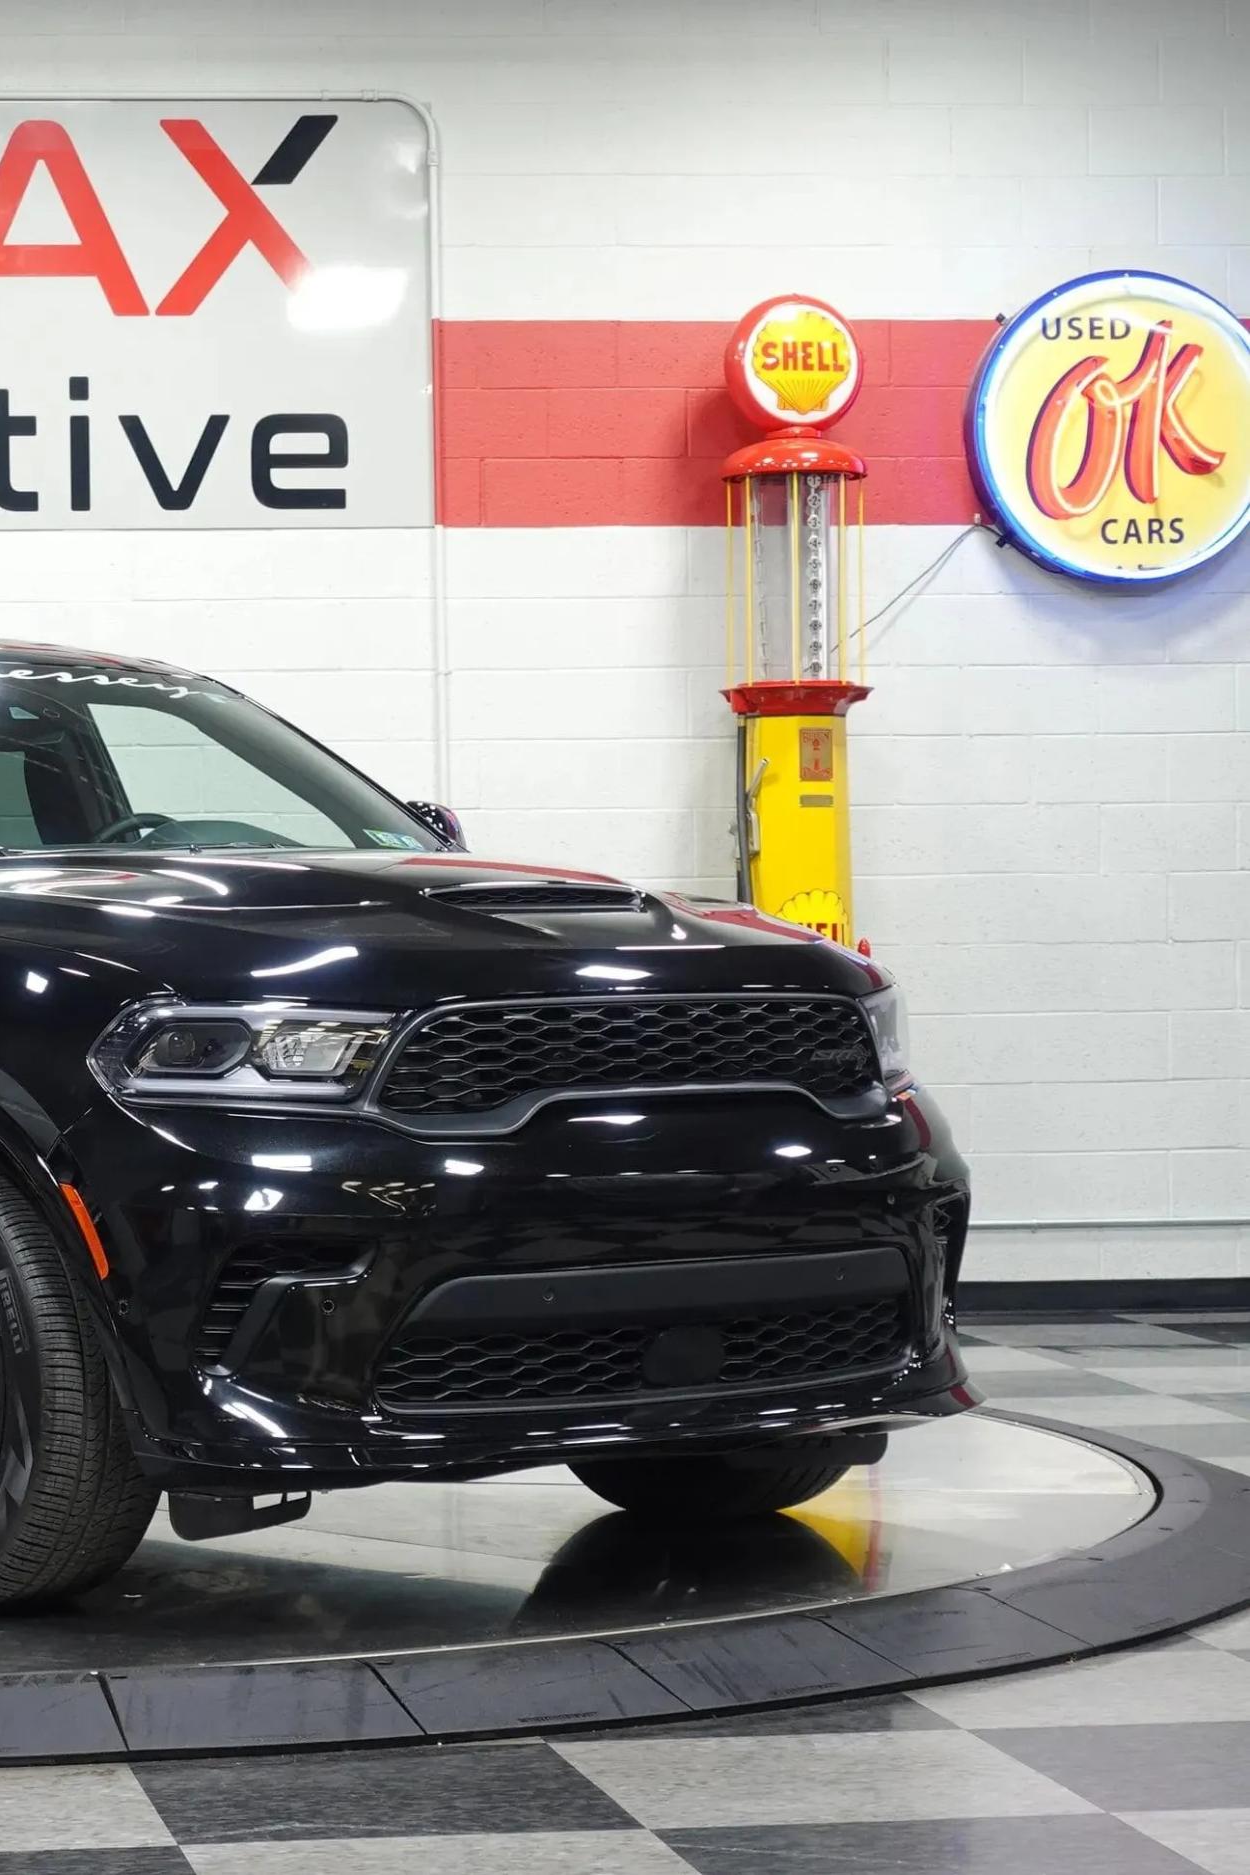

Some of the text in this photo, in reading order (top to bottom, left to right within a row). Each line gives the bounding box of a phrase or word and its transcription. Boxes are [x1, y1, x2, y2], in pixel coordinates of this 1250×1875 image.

[1041, 317, 1131, 341] USED
[761, 341, 845, 373] SHELL
[1026, 320, 1227, 520] OK
[1101, 518, 1185, 544] CARS
